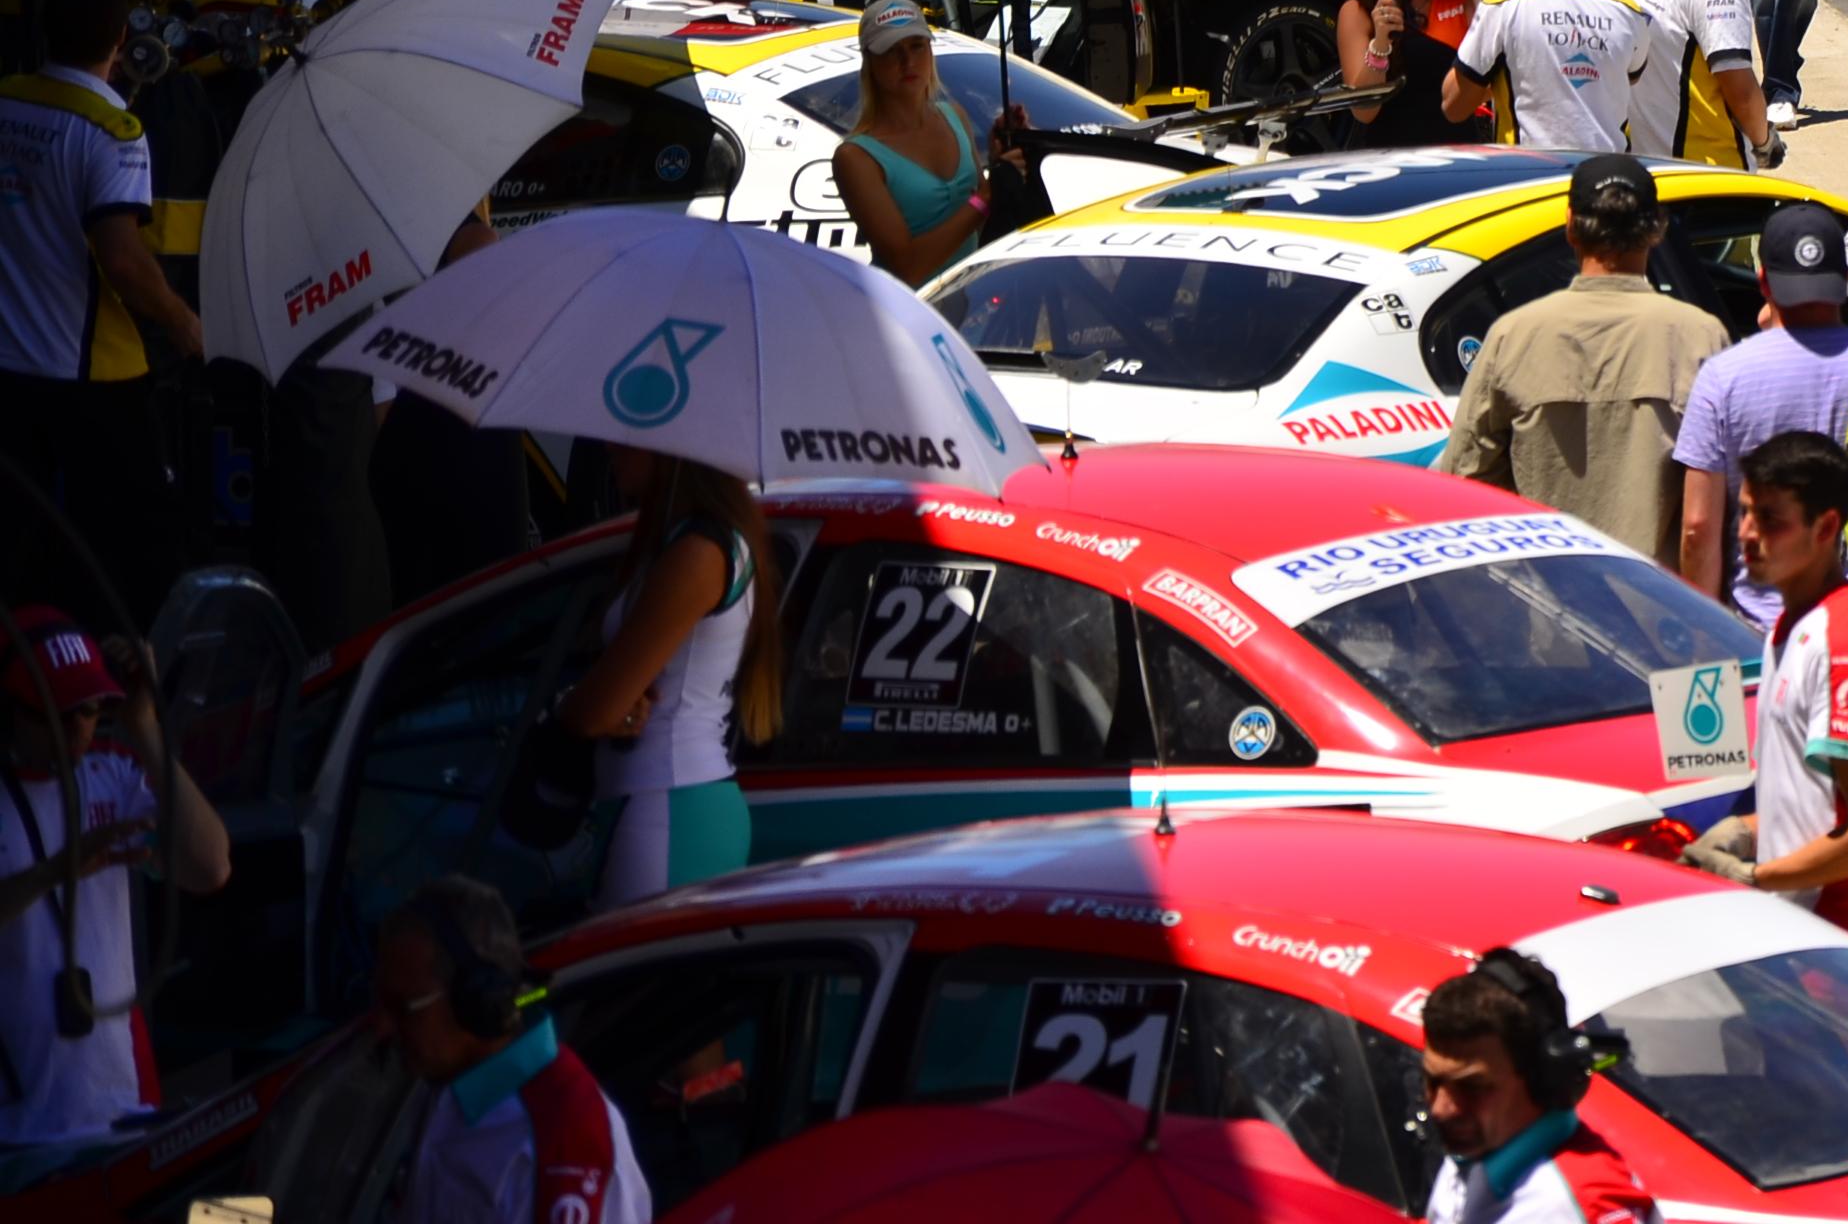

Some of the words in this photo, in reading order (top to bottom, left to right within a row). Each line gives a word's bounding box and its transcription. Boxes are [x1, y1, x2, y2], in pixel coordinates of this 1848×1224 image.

[1541, 11, 1613, 32] RENAULT
[1005, 231, 1371, 272] FLUENCE
[286, 249, 373, 328] FRAM
[361, 327, 499, 399] PETRONAS
[1281, 401, 1452, 445] PALADINI
[780, 428, 961, 471] PETRONAS
[1276, 546, 1365, 580] RIO
[1373, 518, 1570, 552] URUGUAY
[1369, 533, 1606, 575] SEGUROS
[860, 585, 976, 682] 22
[873, 681, 940, 700] PIRELLI
[1667, 750, 1746, 770] PETRONAS
[1060, 983, 1126, 1006] Mobil
[1030, 1012, 1170, 1117] 21
